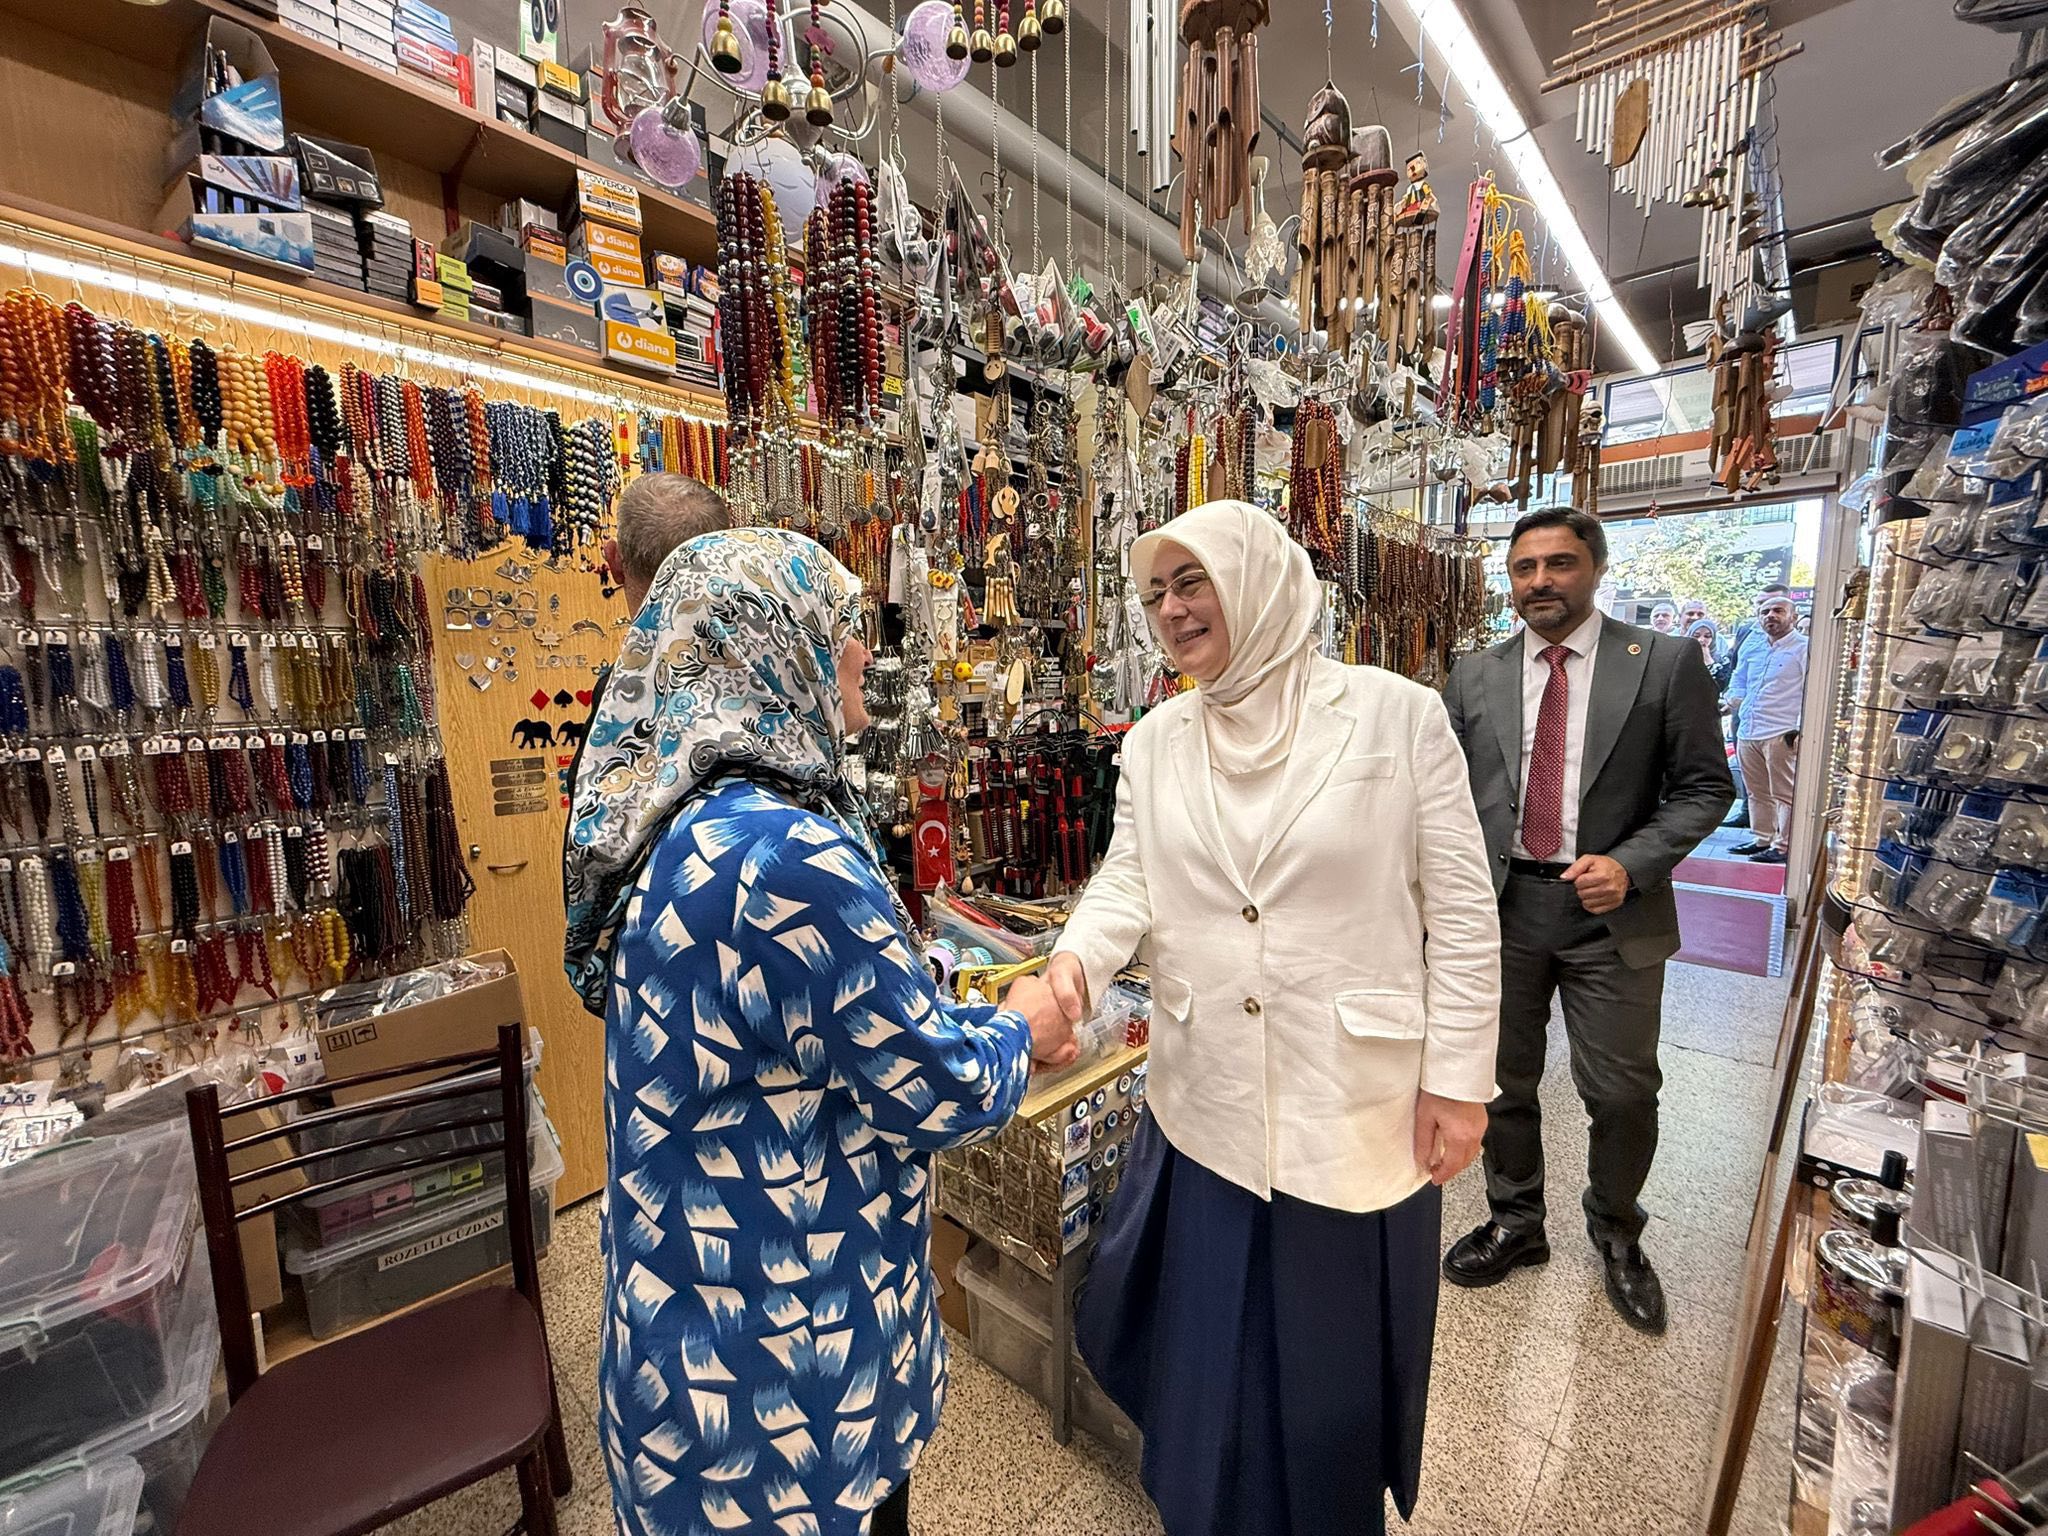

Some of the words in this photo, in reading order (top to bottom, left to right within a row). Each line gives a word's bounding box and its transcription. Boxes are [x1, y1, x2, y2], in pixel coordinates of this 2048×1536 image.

[583, 172, 635, 195] POWERDEX
[607, 235, 635, 251] diana
[612, 265, 640, 279] diana
[634, 338, 670, 357] diana
[534, 654, 588, 668] LOVE
